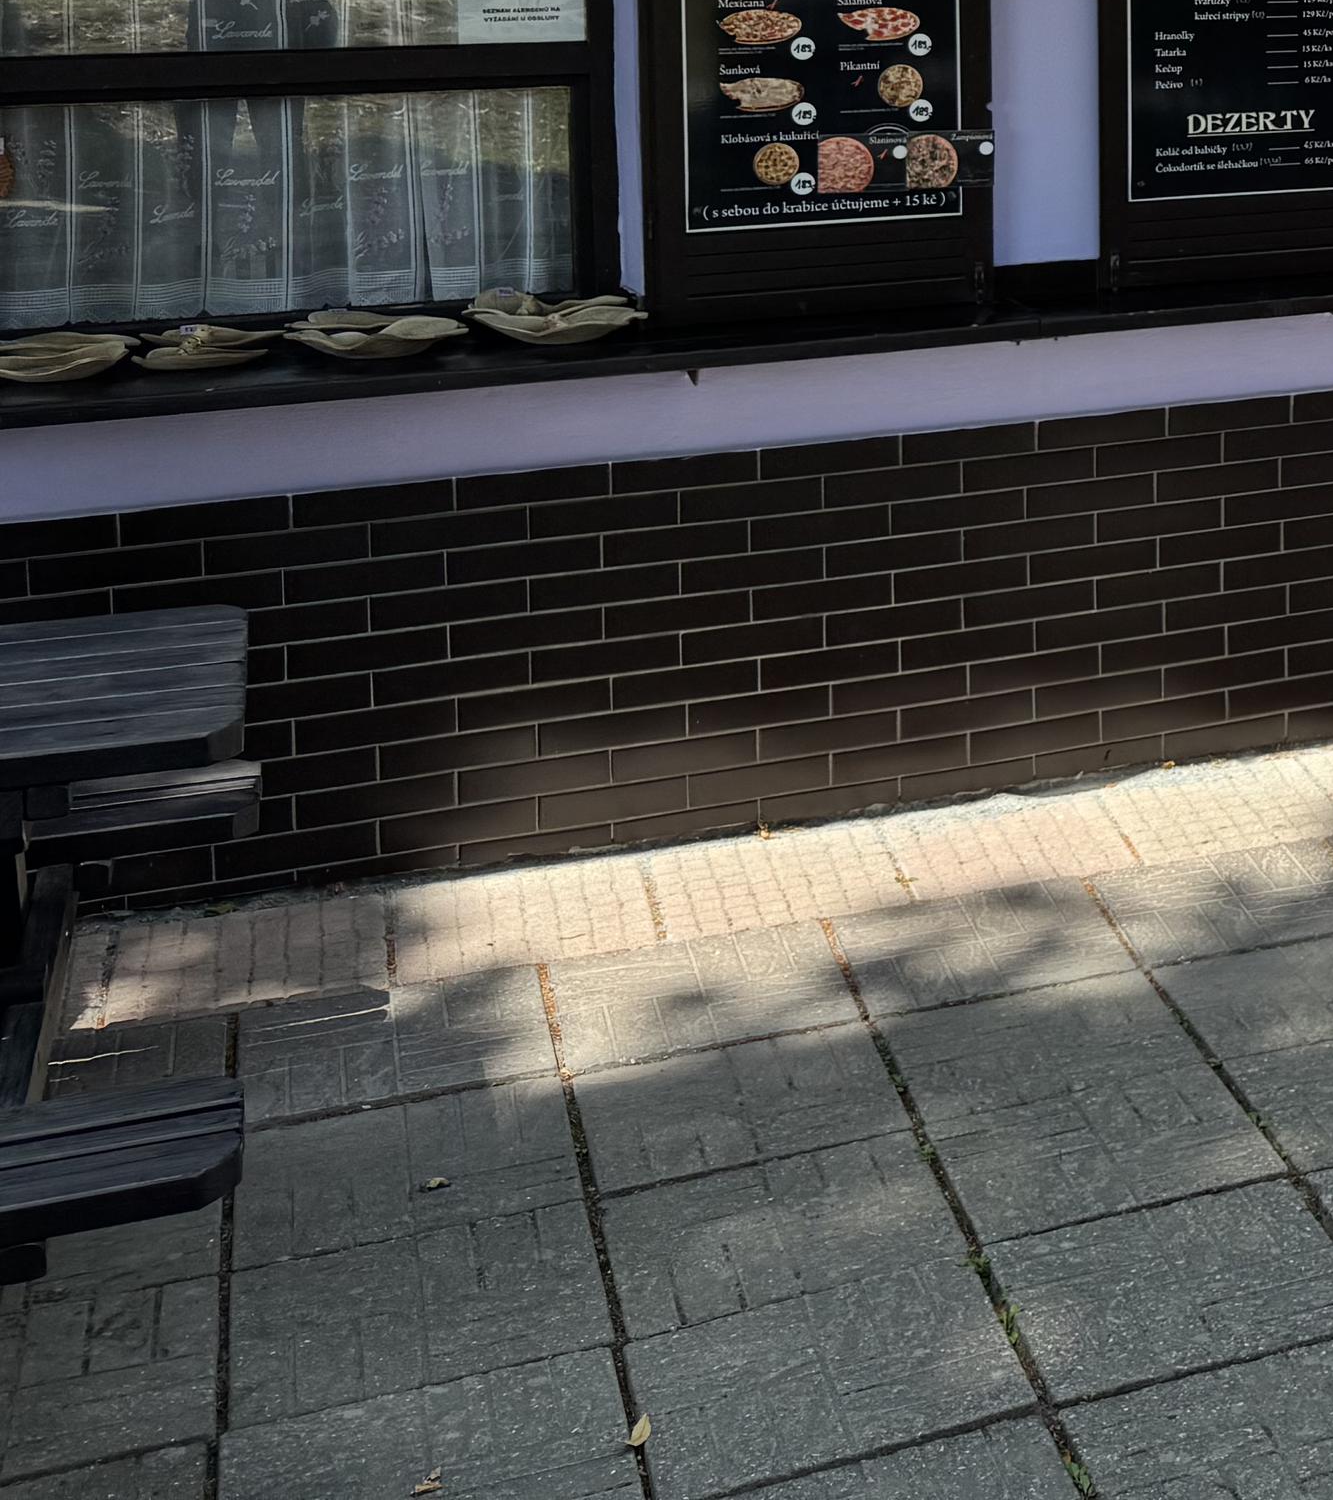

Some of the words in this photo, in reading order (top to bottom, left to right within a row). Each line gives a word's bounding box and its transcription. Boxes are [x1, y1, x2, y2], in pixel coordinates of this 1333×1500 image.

[718, 0, 765, 8] Mexicana
[1222, 11, 1250, 21] stripsy
[1155, 48, 1186, 57] Tatarka
[719, 64, 761, 76] Šunková
[840, 60, 880, 71] Pikantní
[1155, 64, 1183, 75] Kečup
[1155, 80, 1183, 90] Pečivo
[1187, 109, 1315, 135] DEZERTY
[721, 133, 771, 145] Klobásová
[1181, 147, 1194, 156] od
[712, 210, 719, 218] s
[721, 205, 759, 218] sebou
[763, 204, 780, 216] do
[782, 202, 828, 214] krabice
[831, 198, 890, 213] účtujeme
[893, 199, 901, 207] +
[905, 197, 920, 207] 15
[922, 195, 937, 206] kč
